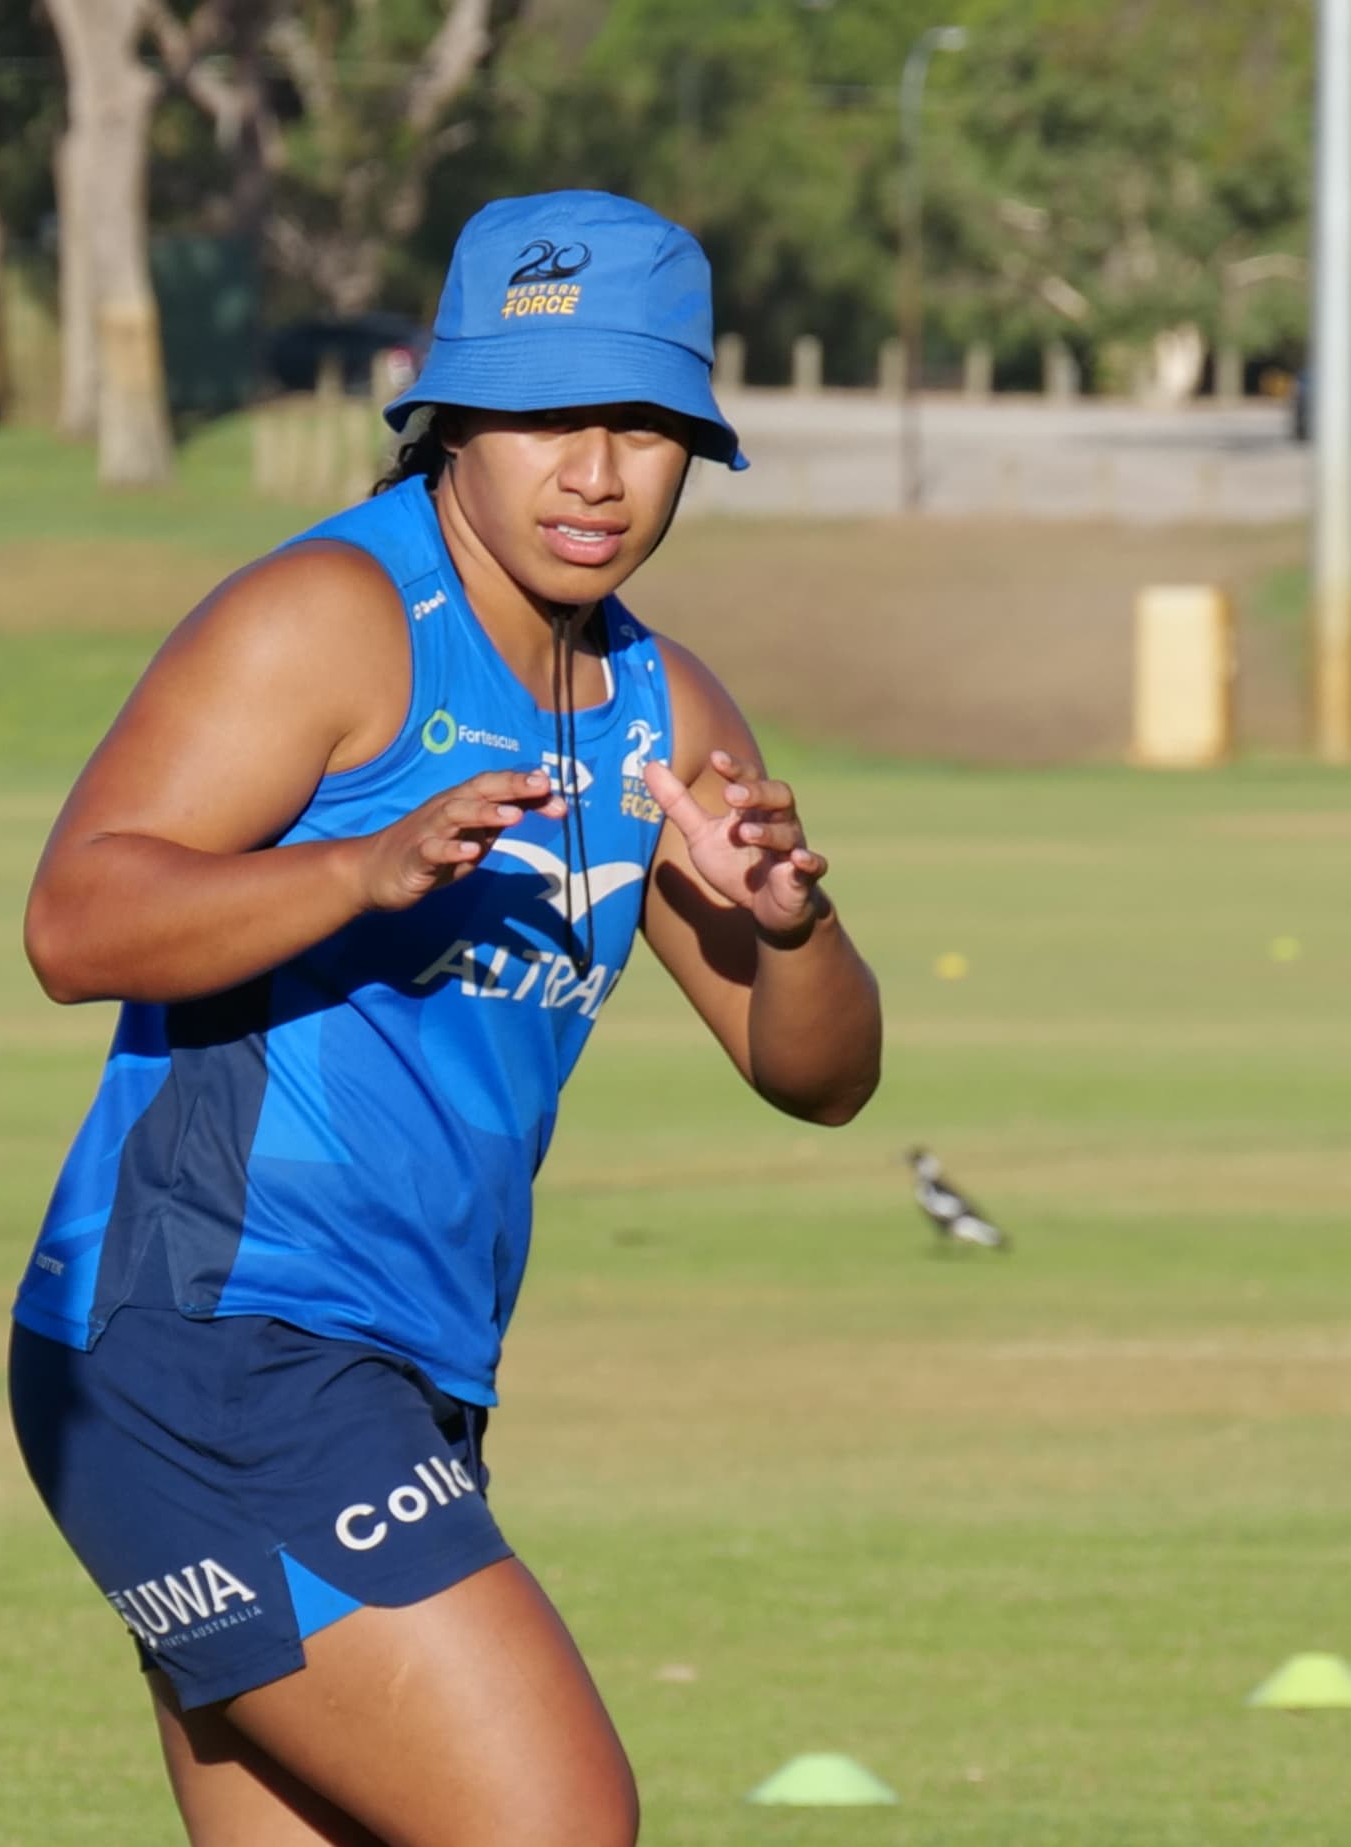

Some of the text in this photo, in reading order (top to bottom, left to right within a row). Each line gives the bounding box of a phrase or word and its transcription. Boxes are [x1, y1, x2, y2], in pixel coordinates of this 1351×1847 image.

[506, 284, 582, 299] WESTERN
[501, 296, 580, 319] FORCE
[458, 725, 520, 752] Fortescue
[411, 938, 621, 1020] ALTRA
[122, 1558, 256, 1635] UWA
[190, 1605, 263, 1641] AUSTRALIA
